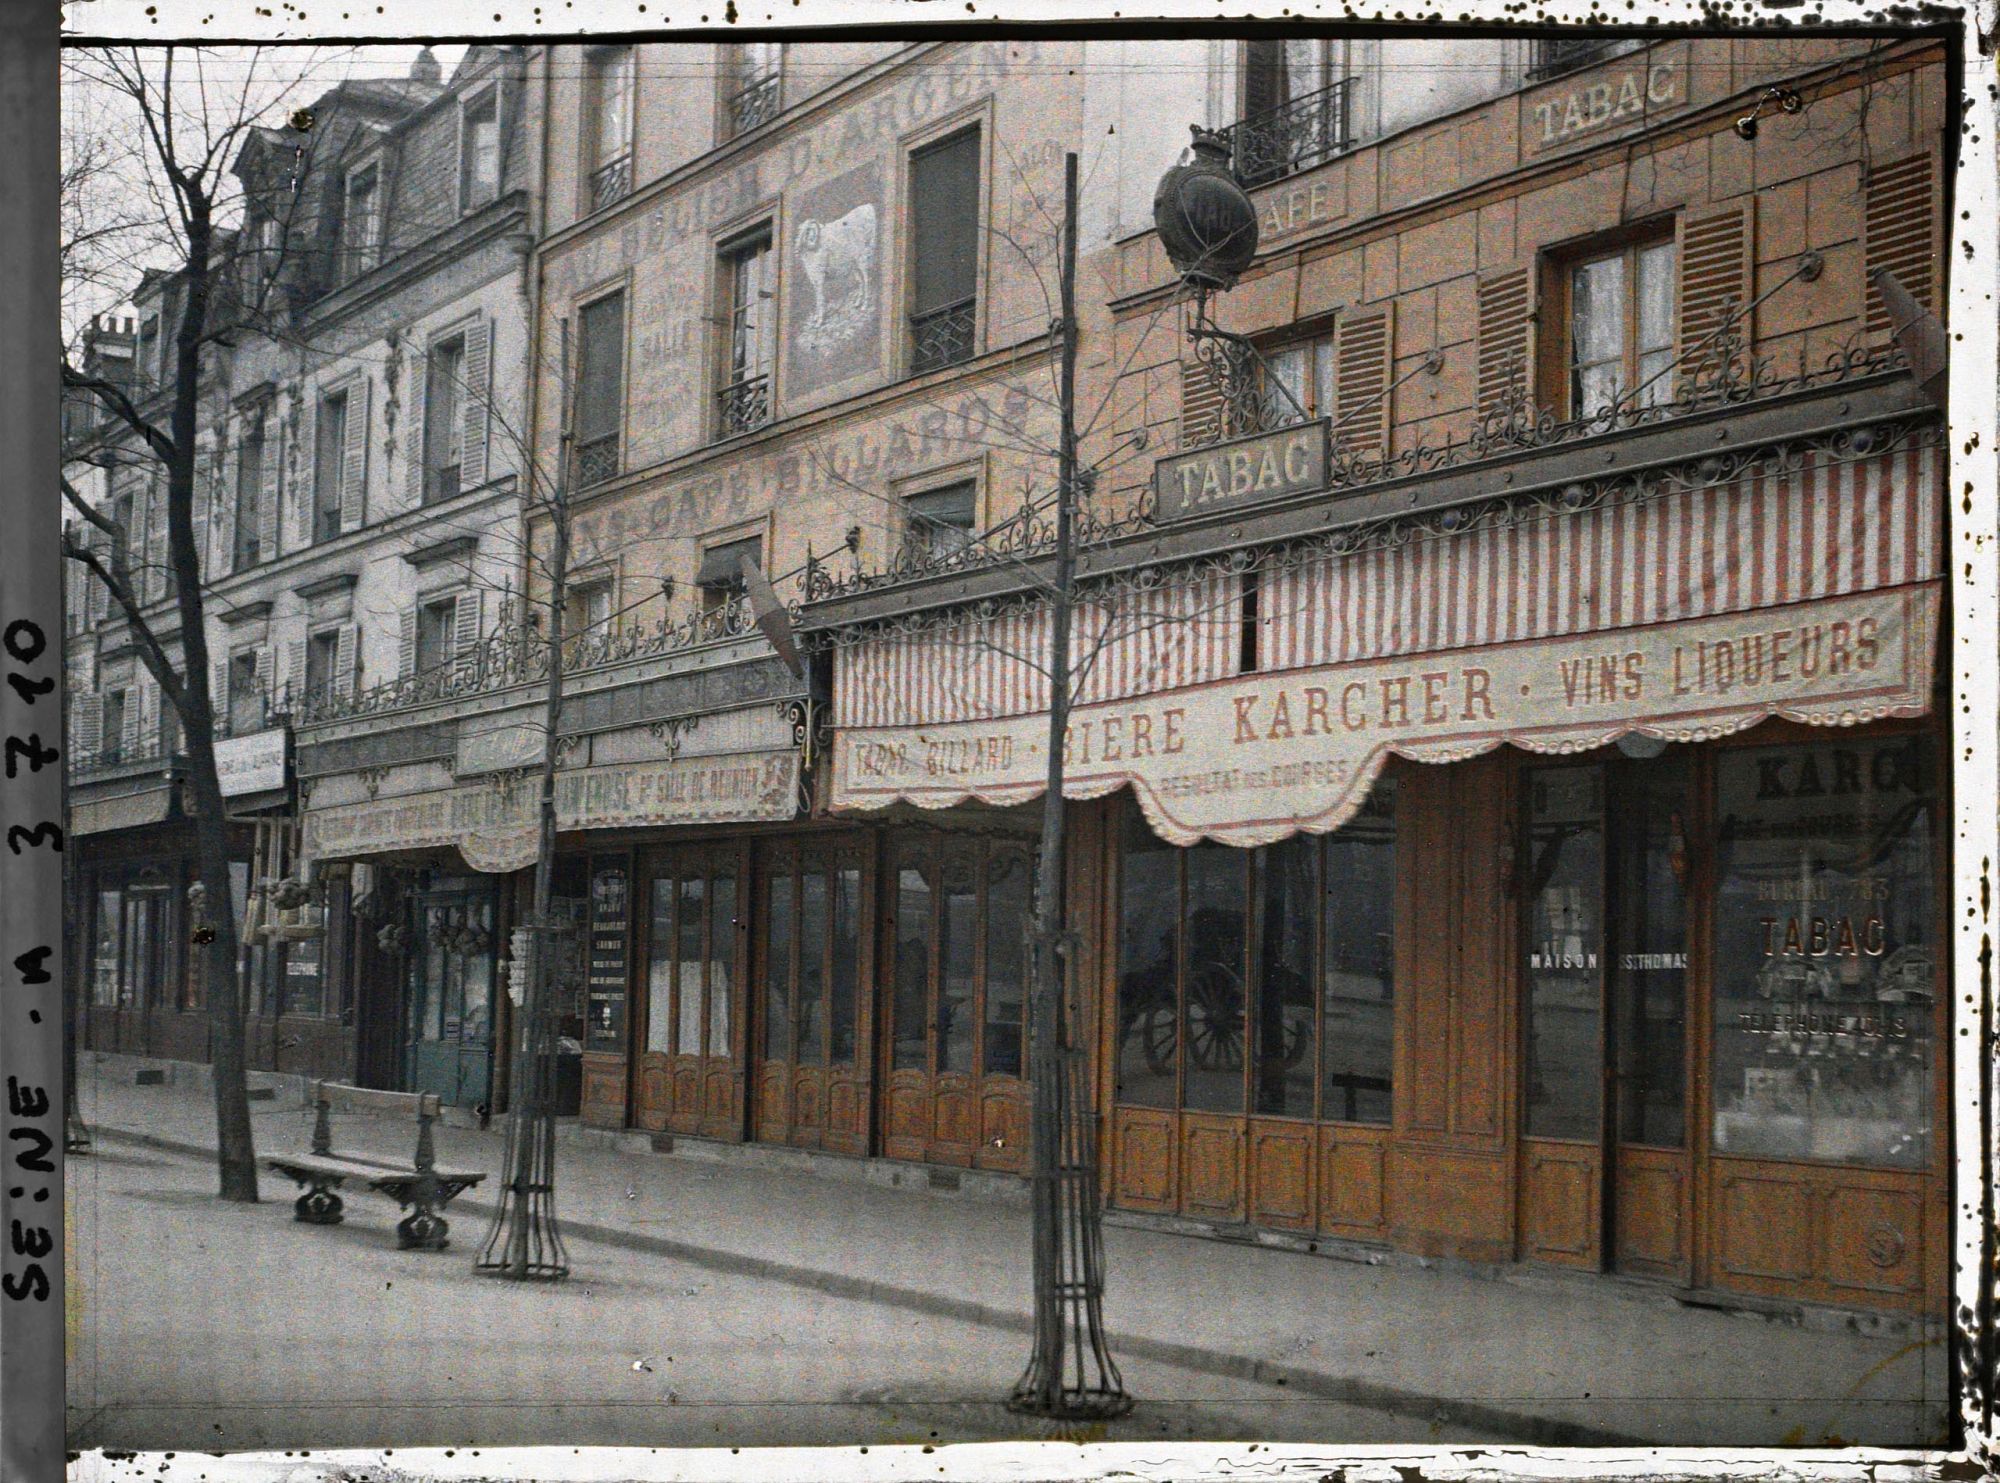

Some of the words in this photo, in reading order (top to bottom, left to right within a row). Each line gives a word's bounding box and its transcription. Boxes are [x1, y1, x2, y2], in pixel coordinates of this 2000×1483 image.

[1532, 64, 1676, 144] TABAC
[1258, 181, 1331, 240] AFE
[1176, 434, 1310, 508] TABAC
[927, 735, 1013, 777] BILLARD
[1233, 667, 1497, 745] KARCHER
[1559, 651, 1647, 707] VINS
[1672, 617, 1881, 696] LIQUEURS
[1530, 952, 1598, 970] MAISON
[1760, 917, 1887, 958] TABAC
